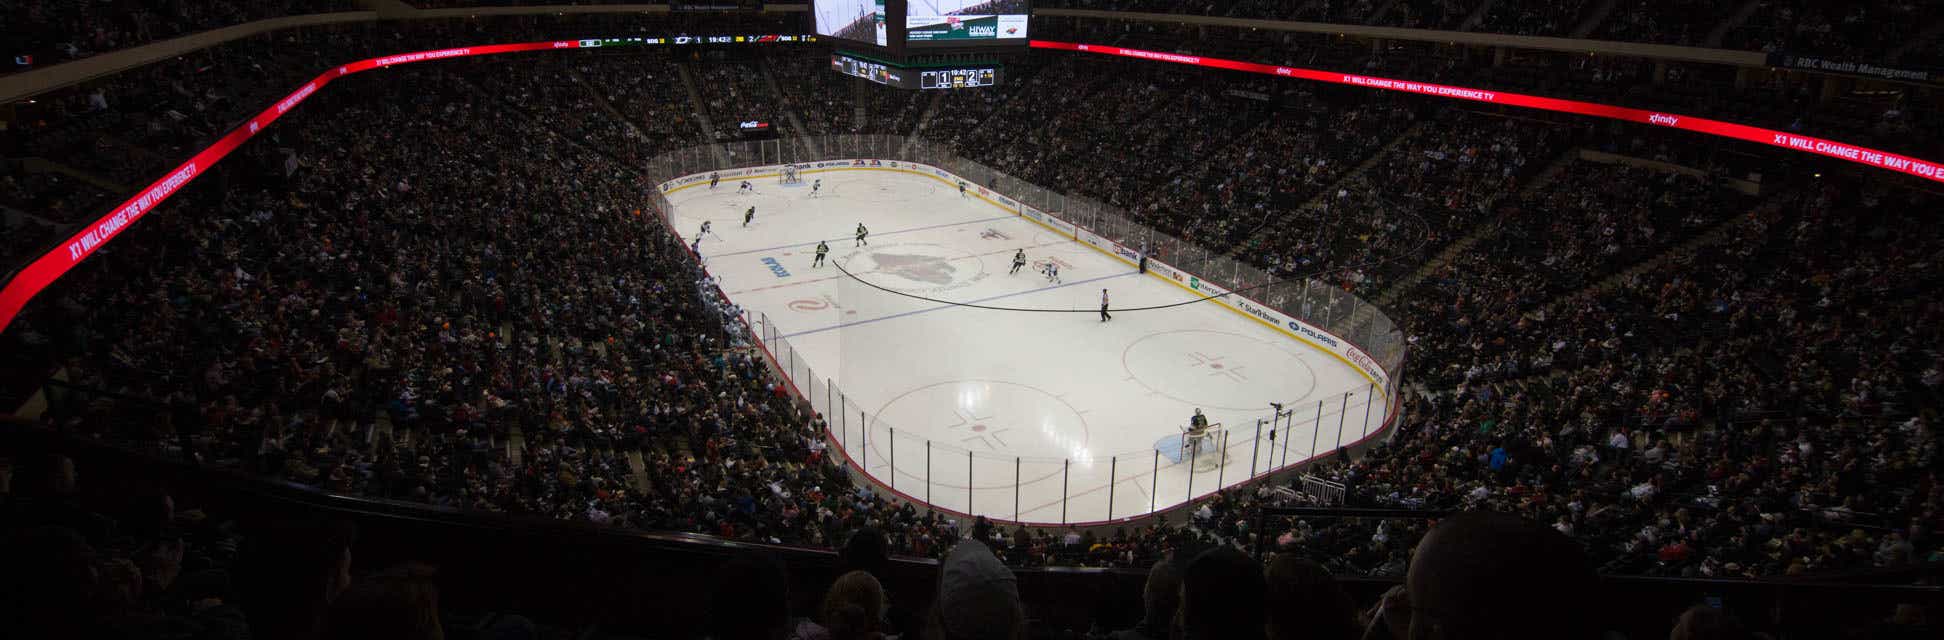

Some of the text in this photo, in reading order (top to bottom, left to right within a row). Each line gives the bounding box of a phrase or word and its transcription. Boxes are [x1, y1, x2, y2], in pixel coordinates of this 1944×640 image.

[1821, 60, 1856, 72] Wealth
[1857, 63, 1929, 80] Management
[1351, 77, 1366, 85] WILL
[1366, 78, 1392, 88] CHANGE
[1393, 81, 1404, 90] THE
[1406, 83, 1421, 92] WAY
[1422, 85, 1438, 94] YOU
[1438, 87, 1483, 99] EXPERIENCE
[1484, 92, 1495, 100] TV
[1649, 113, 1678, 126] xfinity
[1774, 134, 1787, 145] X1
[1789, 137, 1814, 150] WILL
[1816, 142, 1859, 160] CHANGE
[1861, 151, 1882, 164] THE
[1884, 156, 1912, 170] WAY
[1911, 162, 1936, 176] YOU
[69, 241, 82, 260] X1
[80, 230, 102, 251] WILL
[99, 210, 128, 239] CHANGE
[126, 201, 140, 220] THE
[137, 194, 153, 213] WAY
[151, 184, 164, 202] YOU
[162, 166, 192, 194] EXPERIENCE
[1245, 304, 1281, 326] StarTribune
[1301, 327, 1337, 347] POLARIS
